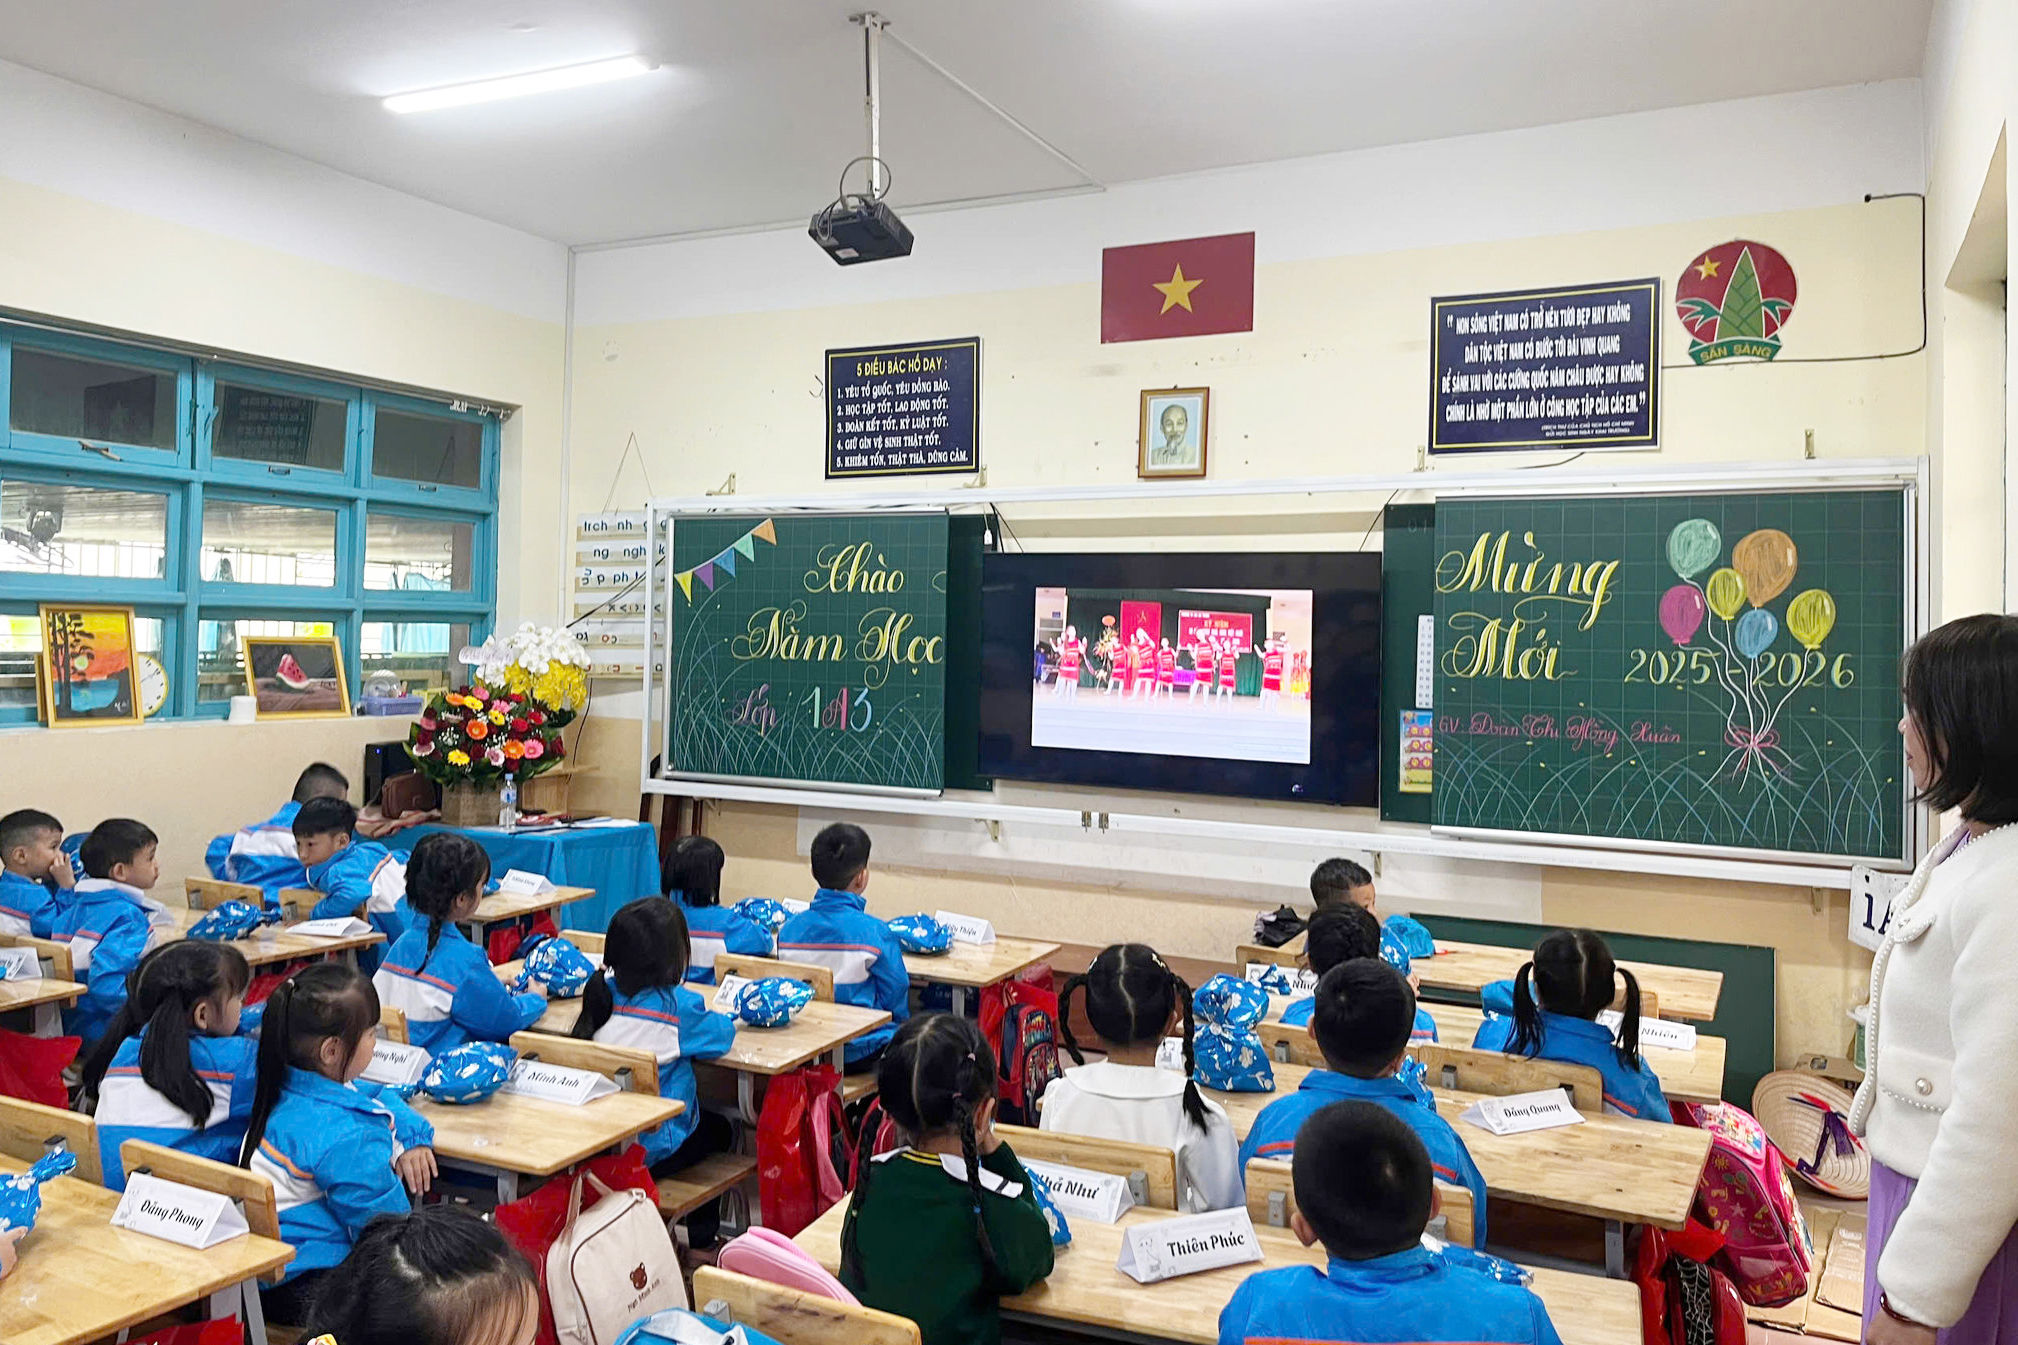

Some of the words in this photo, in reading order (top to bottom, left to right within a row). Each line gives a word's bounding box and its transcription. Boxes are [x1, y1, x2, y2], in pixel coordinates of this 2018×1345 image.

[1470, 312, 1487, 334] SÔNG
[1488, 310, 1503, 336] VIỆT
[1504, 313, 1519, 331] NAM
[1520, 308, 1528, 330] CÓ
[1545, 306, 1559, 328] NÊN
[1576, 307, 1590, 329] ĐẸP
[1592, 305, 1606, 324] HAY
[1607, 300, 1630, 323] KHÔNG
[1465, 340, 1478, 364] DÂN
[1480, 340, 1492, 366] TỘC
[1493, 338, 1508, 364] VIỆT
[1509, 342, 1524, 360] NAM
[1525, 336, 1534, 360] CÓ
[1555, 334, 1566, 357] TỚI
[1580, 336, 1596, 356] VINH
[1597, 334, 1620, 357] QUANG
[856, 363, 862, 376] 5
[888, 356, 906, 374] BÁC
[923, 356, 942, 374] DẠY
[1482, 369, 1493, 391] VỚI
[1494, 368, 1507, 390] CÁC
[1508, 366, 1530, 390] CƯỜNG
[1530, 363, 1549, 392] QUỐC
[1566, 363, 1585, 387] CHÂU
[1585, 363, 1604, 388] ĐƯỢC
[1605, 365, 1620, 384] HAY
[1620, 359, 1644, 383] KHÔNG
[837, 388, 844, 399] 1.
[845, 384, 860, 398] YÊU
[896, 380, 910, 395] YÊU
[837, 405, 844, 416] 2.
[845, 404, 860, 418] HỌC
[862, 401, 875, 417] TẬP
[877, 398, 893, 414] TỐT,
[895, 402, 908, 412] LAO
[910, 398, 930, 413] ĐỘNG
[932, 394, 948, 409] TỐT.
[1446, 400, 1465, 422] CHÍNH
[1476, 398, 1490, 421] NHỜ
[1491, 398, 1505, 423] MỘT
[1547, 395, 1564, 417] CÔNG
[1566, 398, 1580, 420] HỌC
[1581, 392, 1594, 419] TẬP
[1595, 390, 1609, 415] CỦA
[1611, 391, 1624, 414] CÁC
[837, 422, 844, 433] 3.
[845, 419, 864, 433] ĐOÀN
[866, 416, 880, 432] KẾT
[882, 415, 898, 430] TỐT,
[912, 415, 930, 430] LUẬT
[932, 412, 949, 427] TỐT.
[837, 440, 843, 450] 4.
[859, 436, 872, 449] GÌN
[873, 435, 883, 450] VỆ
[884, 436, 901, 448] SINH
[903, 433, 922, 448] THẬT
[924, 430, 941, 446] TỐT.
[836, 456, 843, 467] 5.
[845, 453, 868, 467] KHIÊM
[870, 451, 886, 466] TỐN,
[888, 452, 907, 467] THẬT
[909, 450, 926, 465] THÀ,
[928, 450, 948, 463] DŨNG
[950, 448, 968, 462] CẢM.
[594, 548, 609, 560] ng
[624, 545, 646, 560] ngh
[804, 541, 904, 594] Chào
[1435, 530, 1620, 632] Mừng
[730, 599, 848, 662] Năm
[854, 607, 944, 690] Học
[1441, 611, 1578, 681] Mới
[1624, 649, 1721, 684] 2025
[1753, 651, 1854, 689] 2026
[802, 686, 872, 732] 1A3
[1630, 720, 1681, 744] Xuân
[527, 1070, 558, 1084] Minh
[558, 1074, 580, 1088] Anh
[1530, 1103, 1561, 1115] Quang
[1064, 1179, 1100, 1199] Như
[171, 1208, 204, 1231] Phong
[1167, 1238, 1209, 1257] Thiên
[1210, 1231, 1246, 1251] Phúc
